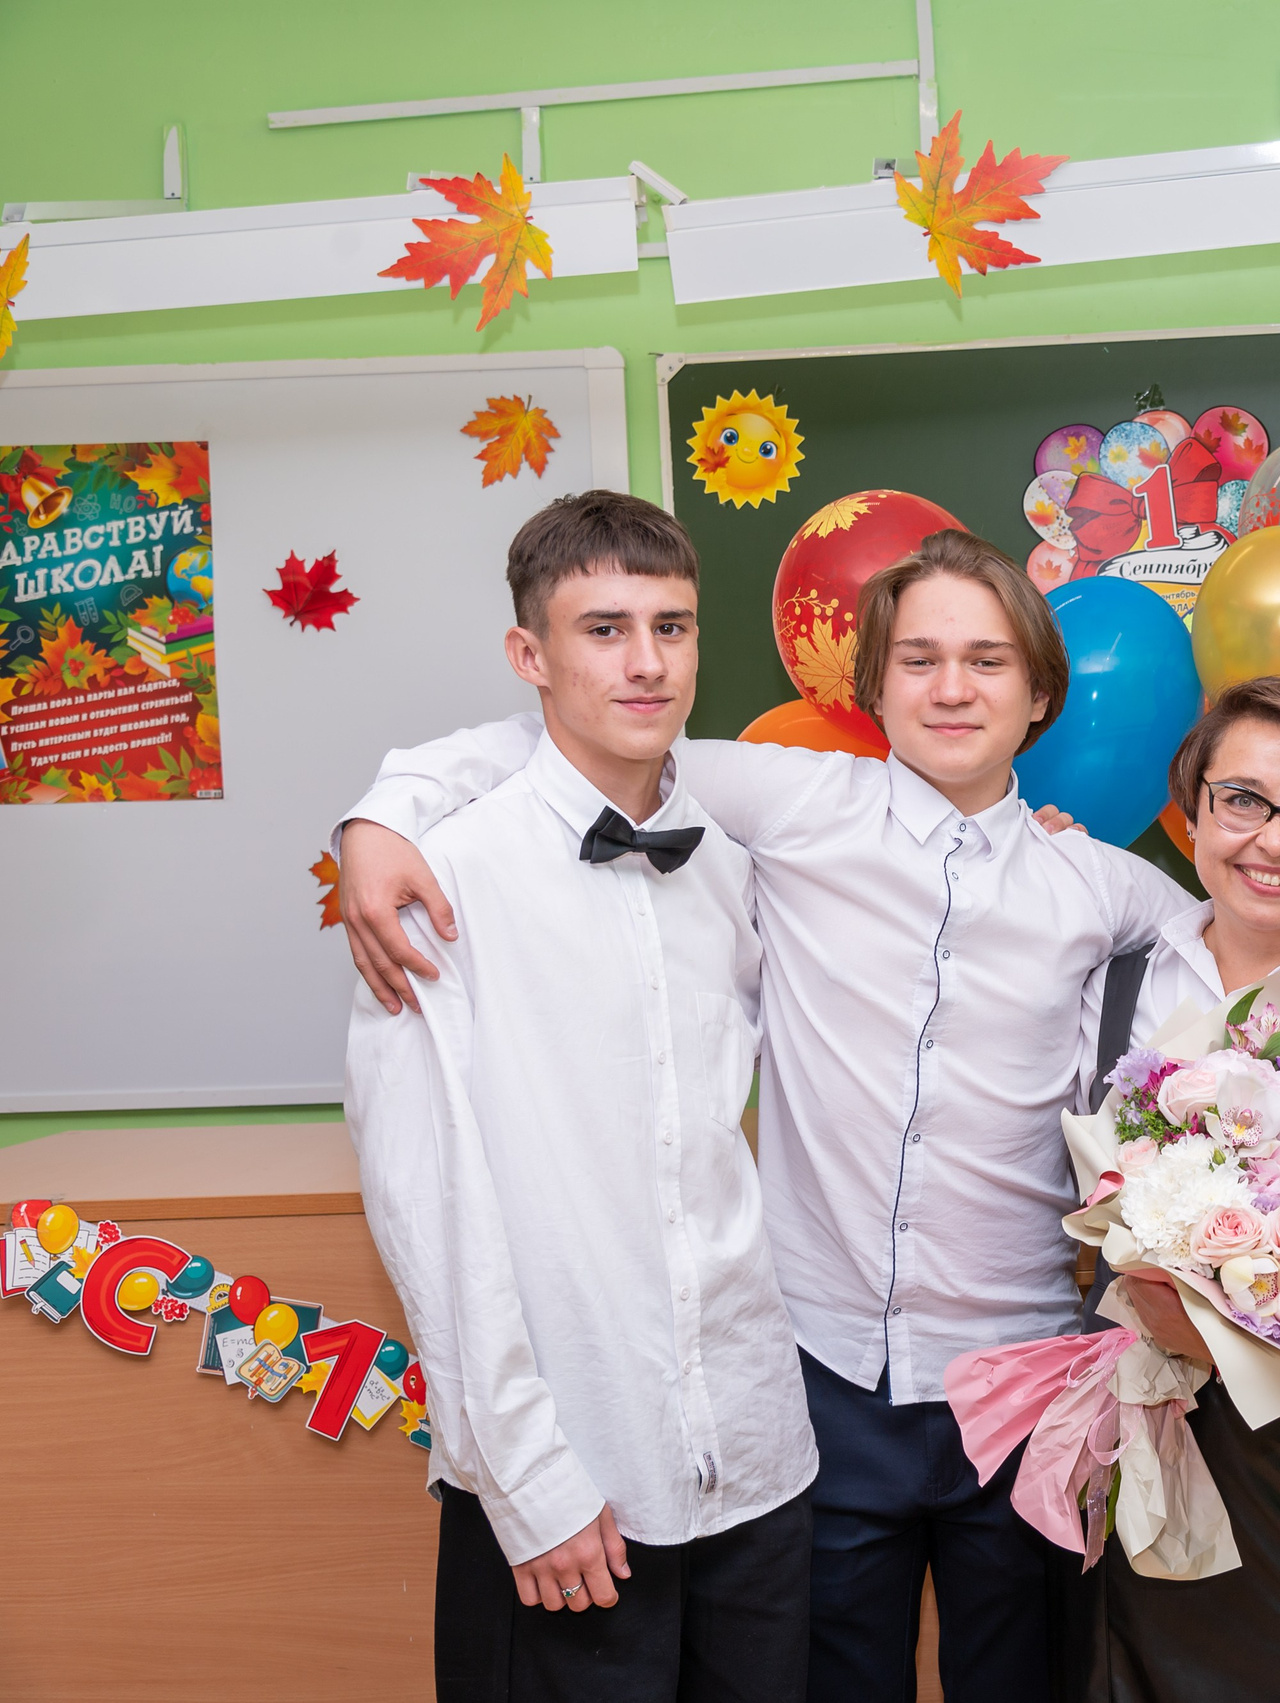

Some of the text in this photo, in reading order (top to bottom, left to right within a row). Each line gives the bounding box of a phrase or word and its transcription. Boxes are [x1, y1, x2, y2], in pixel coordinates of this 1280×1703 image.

[0, 504, 202, 569] ДРАВСТВУЙ,
[1133, 464, 1183, 550] 1
[14, 544, 164, 603] ШКОЛА!
[301, 1320, 387, 1441] 1
